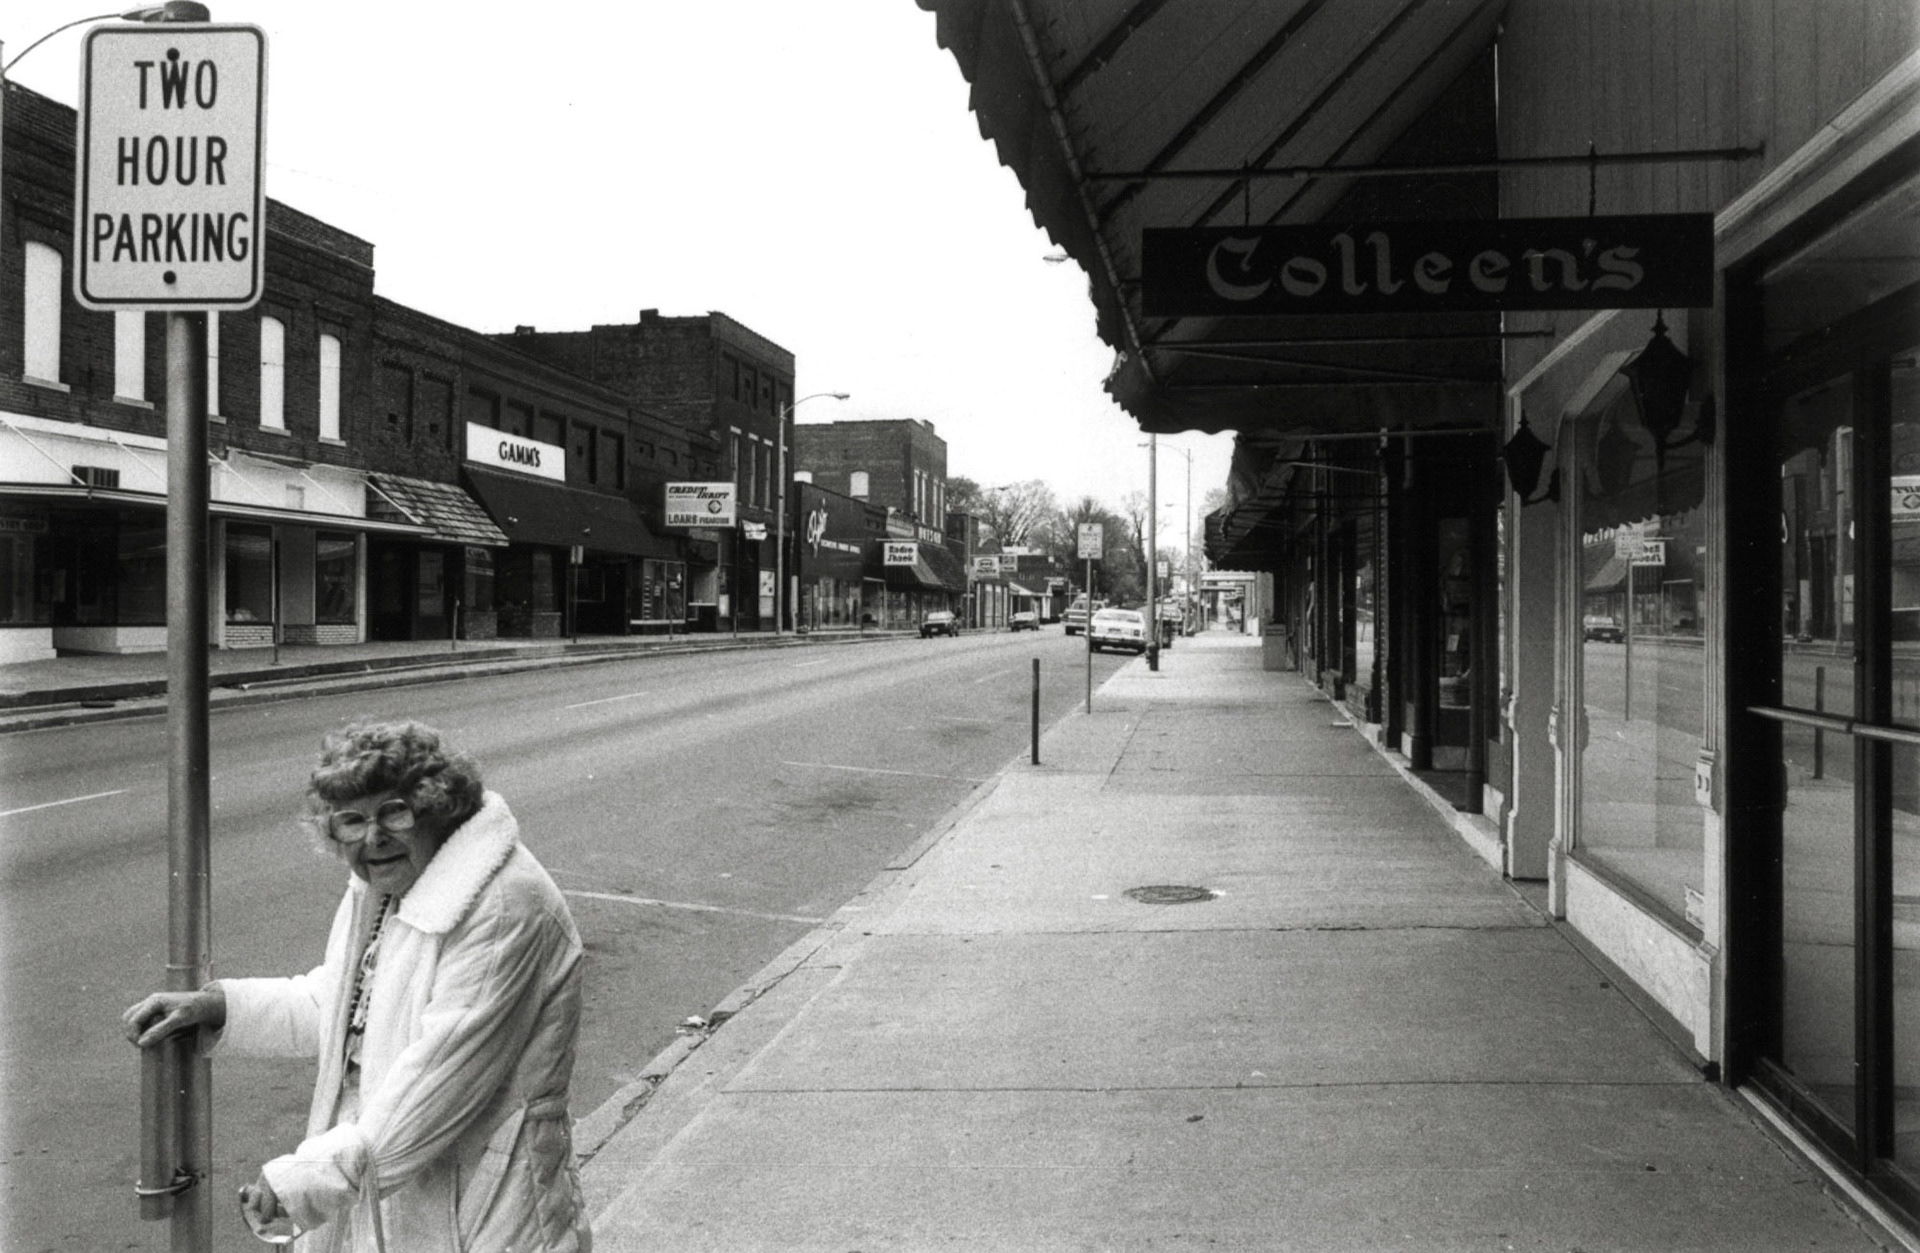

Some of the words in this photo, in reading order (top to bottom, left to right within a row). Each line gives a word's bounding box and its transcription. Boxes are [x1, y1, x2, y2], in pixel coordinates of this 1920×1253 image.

[133, 59, 218, 110] TWO
[117, 135, 228, 186] HOUR
[92, 212, 249, 263] PARKING
[1206, 231, 1645, 300] Colleen's
[498, 440, 541, 468] GAMM'S
[668, 514, 698, 524] LOANS
[887, 554, 914, 562] Shack
[889, 545, 915, 554] Radio
